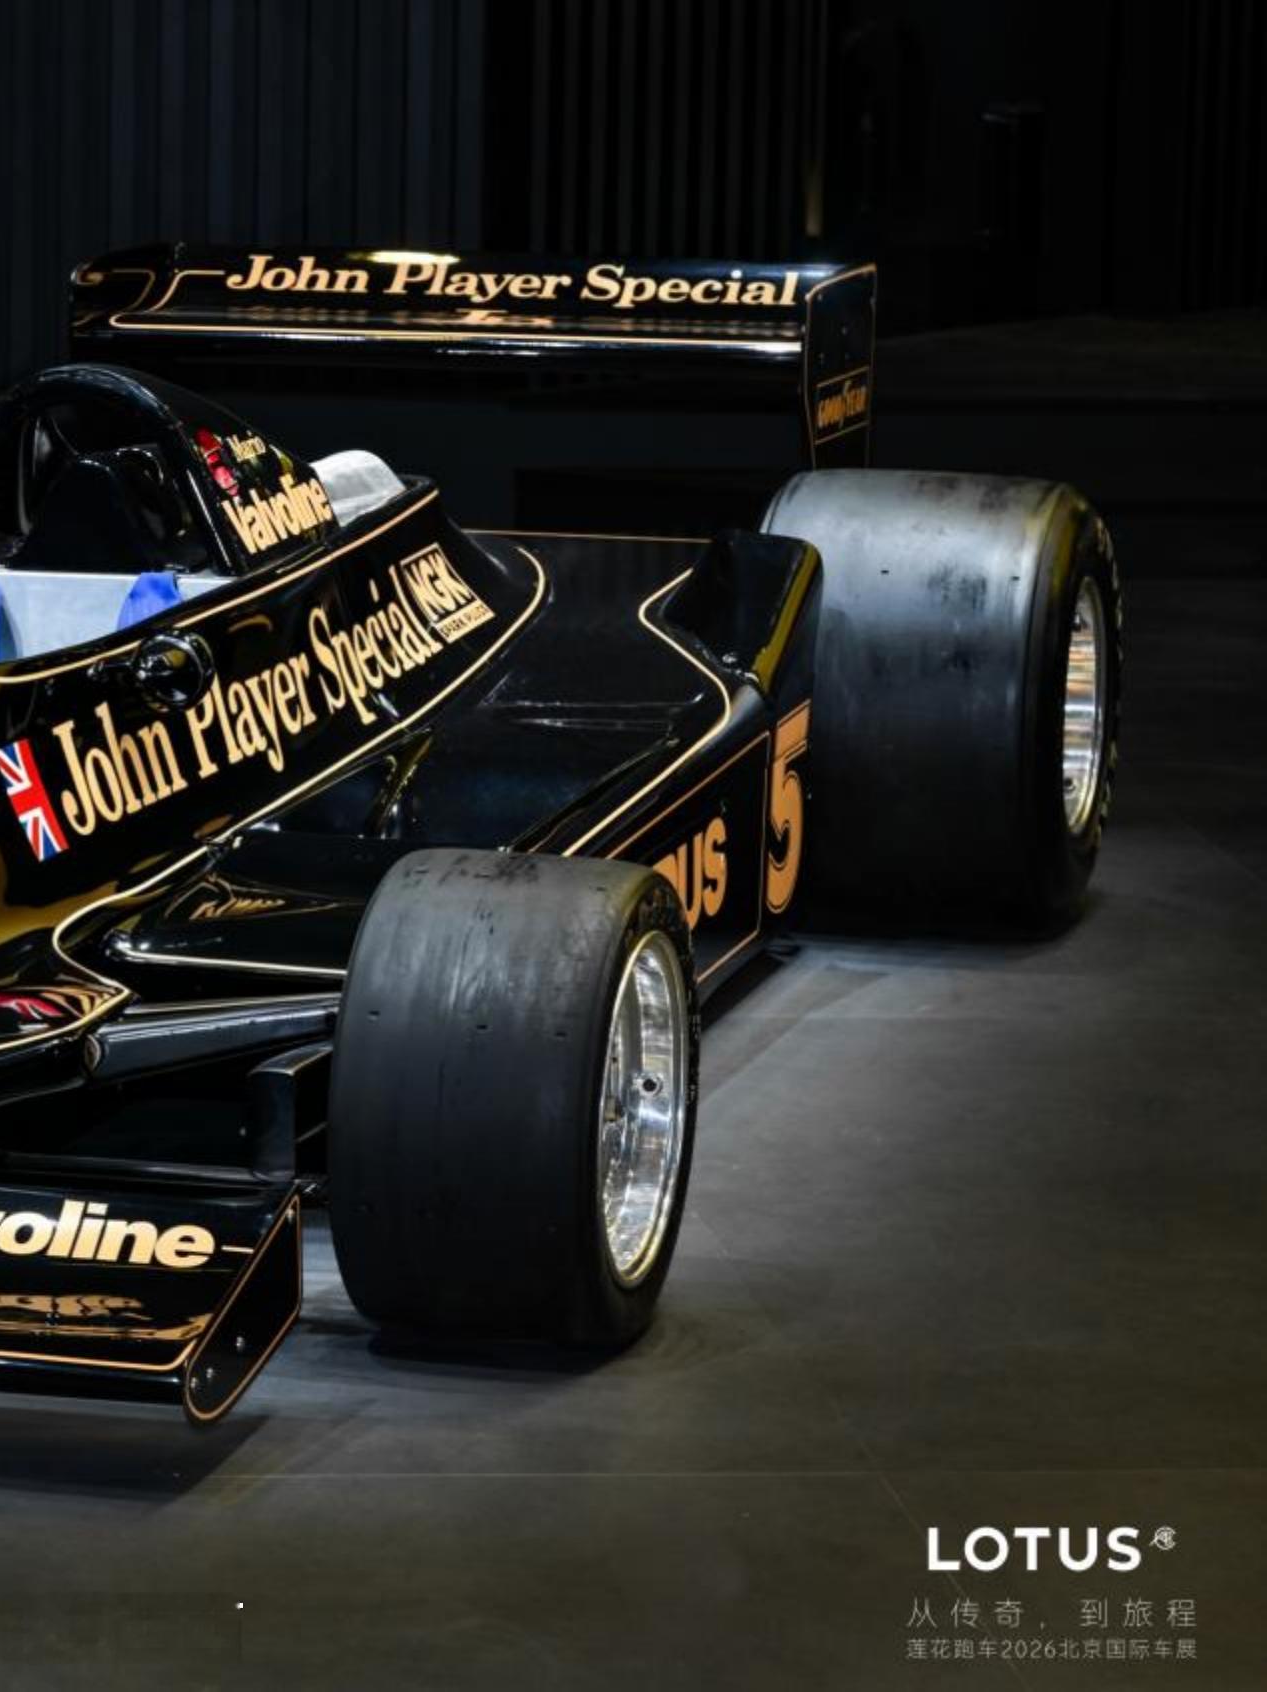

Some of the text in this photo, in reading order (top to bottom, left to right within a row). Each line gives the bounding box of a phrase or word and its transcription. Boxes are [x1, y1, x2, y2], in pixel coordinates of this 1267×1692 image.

[226, 254, 799, 308] John Player Special
[220, 473, 333, 554] Valvoline
[405, 550, 473, 622] NGK
[51, 564, 445, 837] John Player Special
[765, 698, 812, 915] 5
